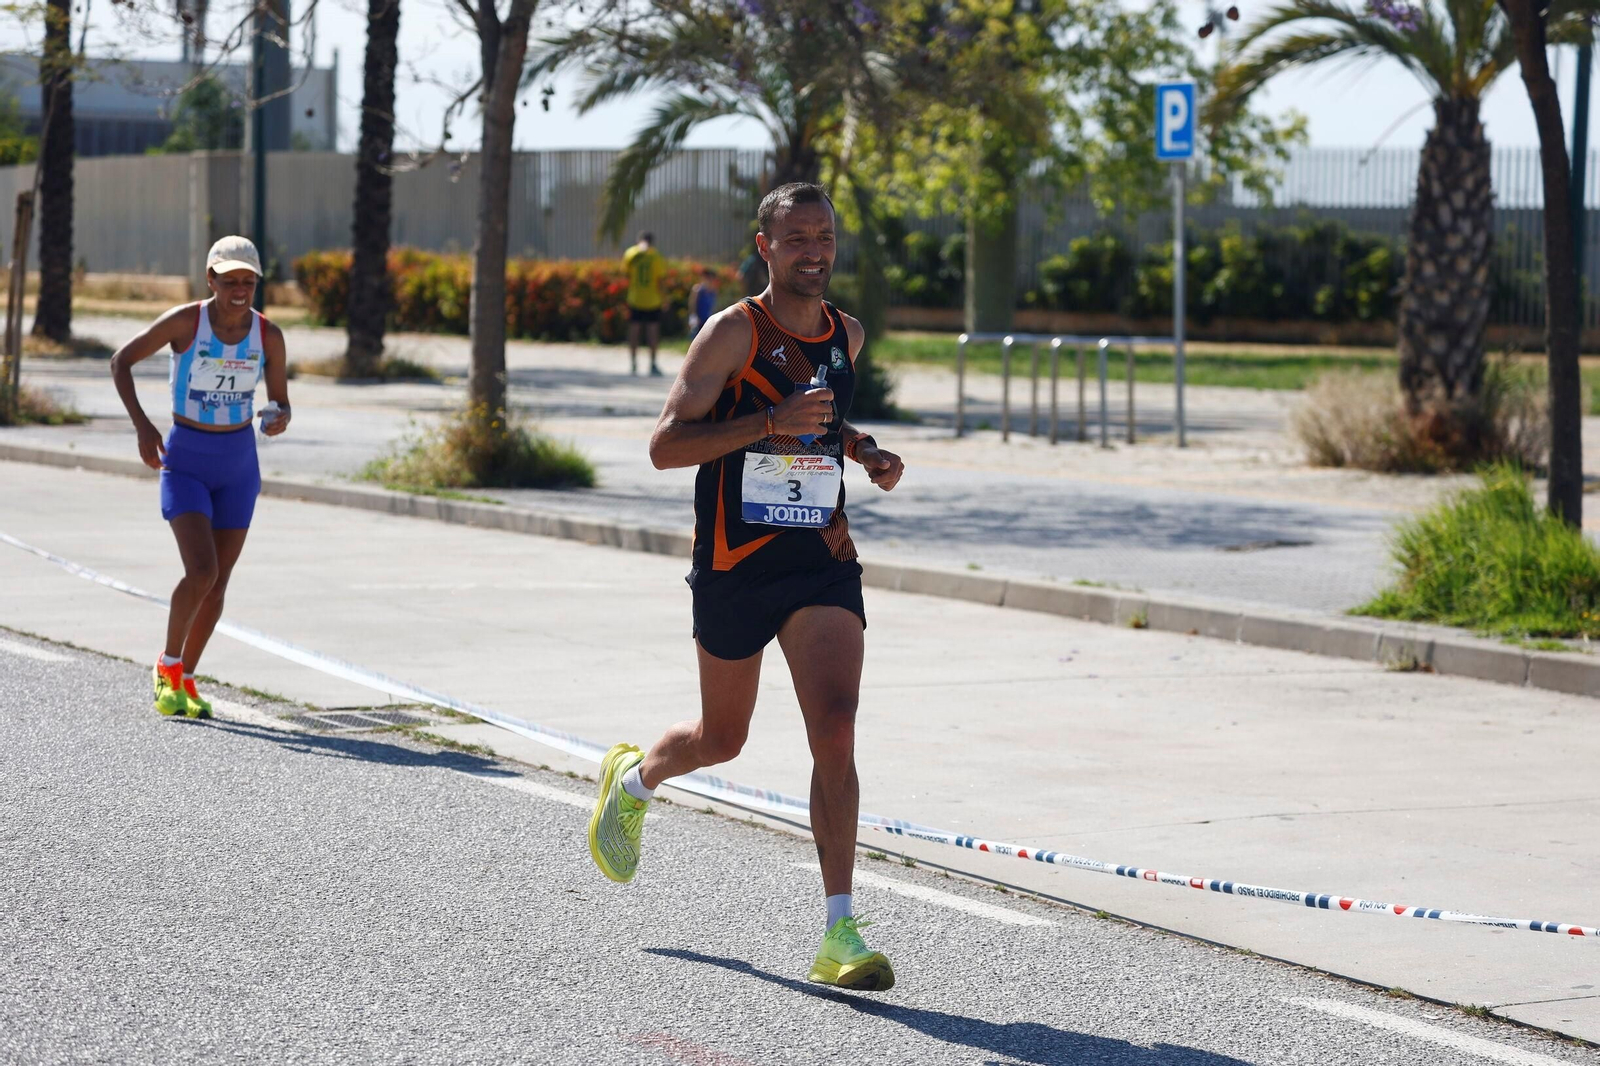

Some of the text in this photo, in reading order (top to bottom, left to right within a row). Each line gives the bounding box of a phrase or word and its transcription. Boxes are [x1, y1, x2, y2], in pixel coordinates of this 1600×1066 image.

[1162, 89, 1188, 151] P
[215, 374, 236, 390] 71
[794, 457, 823, 466] RFEA
[787, 479, 802, 502] 3
[1237, 886, 1301, 902] PROHIBIDO EL PASO
